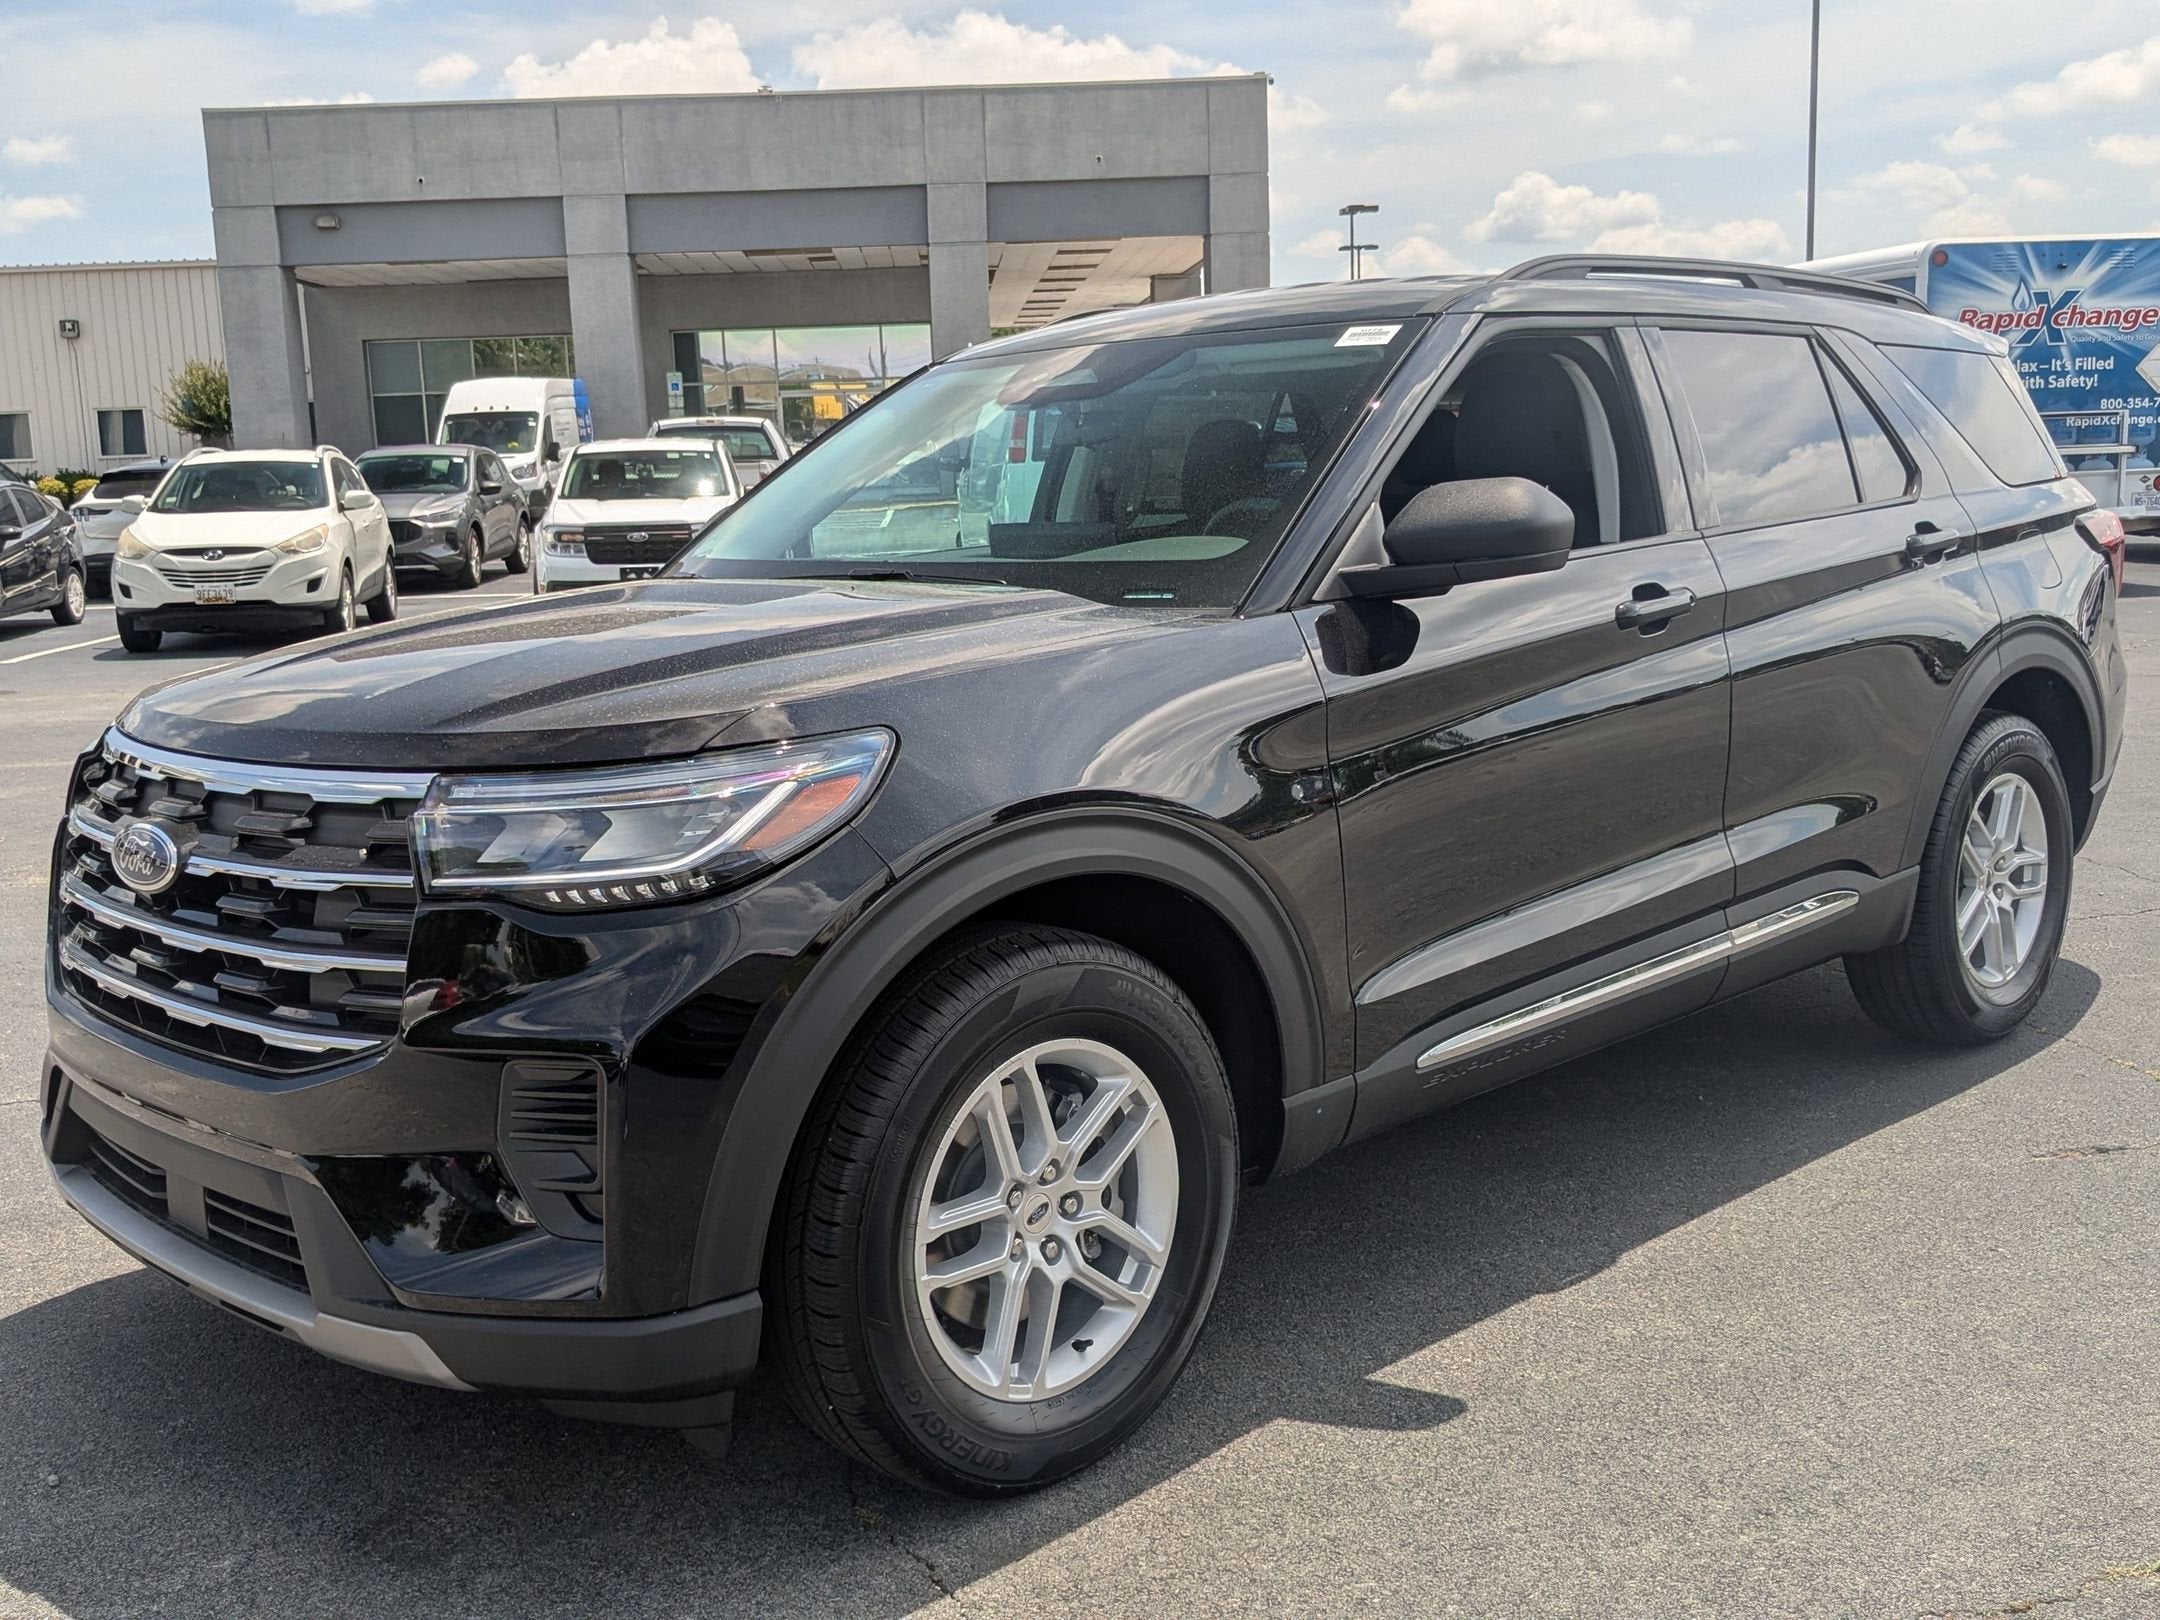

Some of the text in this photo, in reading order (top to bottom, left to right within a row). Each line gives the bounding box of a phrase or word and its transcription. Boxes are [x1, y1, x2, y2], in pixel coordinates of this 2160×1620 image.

[2070, 335, 2096, 344] Quality
[2112, 333, 2135, 342] Safety
[2145, 333, 2156, 341] Go
[2075, 356, 2115, 370] Filled
[2022, 374, 2098, 390] ith Safety!
[2100, 398, 2160, 410] 800-354-7
[911, 1408, 1019, 1472] KINERGY
